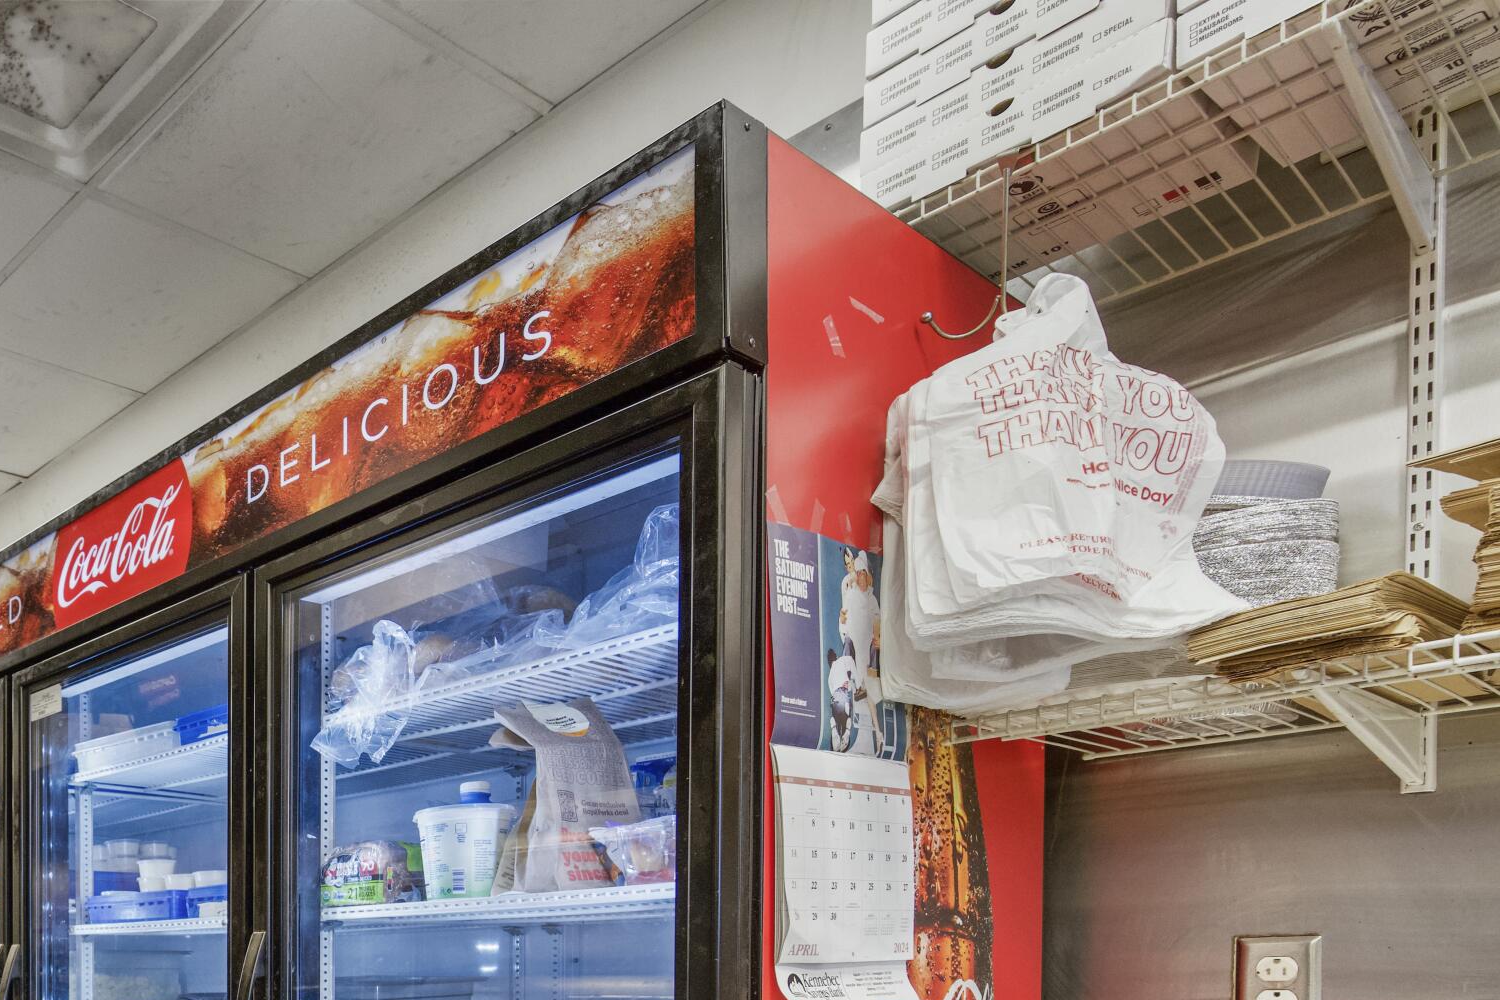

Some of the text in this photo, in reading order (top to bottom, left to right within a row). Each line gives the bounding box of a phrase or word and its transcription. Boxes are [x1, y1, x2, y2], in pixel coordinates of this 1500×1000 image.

[890, 11, 932, 40] EXTRA CHEESE
[995, 8, 1028, 31] MEATBALL
[1103, 16, 1134, 37] SPECIAL
[1199, 10, 1220, 27] EXTRA
[1199, 14, 1230, 35] SAUSAGE
[1199, 15, 1244, 43] MUSHROOMS
[890, 27, 922, 49] PEPPERONI
[994, 23, 1019, 42] ONIONS
[945, 40, 973, 60] SAUSAGE
[1042, 32, 1084, 58] MUSHROOM
[945, 50, 973, 70] PEPPERS
[1042, 44, 1080, 69] ANCHOVIES
[889, 64, 931, 92] EXTRA CHEESE
[991, 64, 1024, 86] MEATBALL
[1103, 65, 1133, 85] SPECIAL
[888, 79, 921, 101] PEPPERONI
[990, 79, 1015, 96] ONIONS
[1042, 79, 1084, 106] MUSHROOM
[940, 103, 969, 122] PEPPERS
[941, 93, 969, 112] SAUSAGE
[1042, 92, 1081, 116] ANCHOVIES
[885, 115, 927, 143] EXTRA CHEESE
[991, 111, 1024, 131] MEATBALL
[885, 130, 917, 152] PEPPERONI
[990, 125, 1015, 142] ONIONS
[940, 148, 969, 166] PEPPERS
[941, 137, 969, 156] SAUSAGE
[885, 159, 927, 185] EXTRA CHEESE
[885, 174, 917, 194] PEPPERONI
[247, 309, 552, 505] DELICIOUS
[1116, 373, 1196, 422] YOU
[977, 409, 1108, 459] THAN
[1112, 422, 1193, 476] YOU
[1113, 478, 1139, 498] Nice
[1140, 485, 1175, 507] Day
[57, 478, 184, 609] Coca-Cola
[773, 538, 790, 559] THE
[775, 557, 815, 583] SATURDAY
[776, 575, 808, 600] EVENING
[777, 594, 798, 615] POST
[788, 941, 909, 957] APRIL 2024
[801, 971, 841, 988] Kennebec
[806, 986, 845, 1000] Savings Bank
